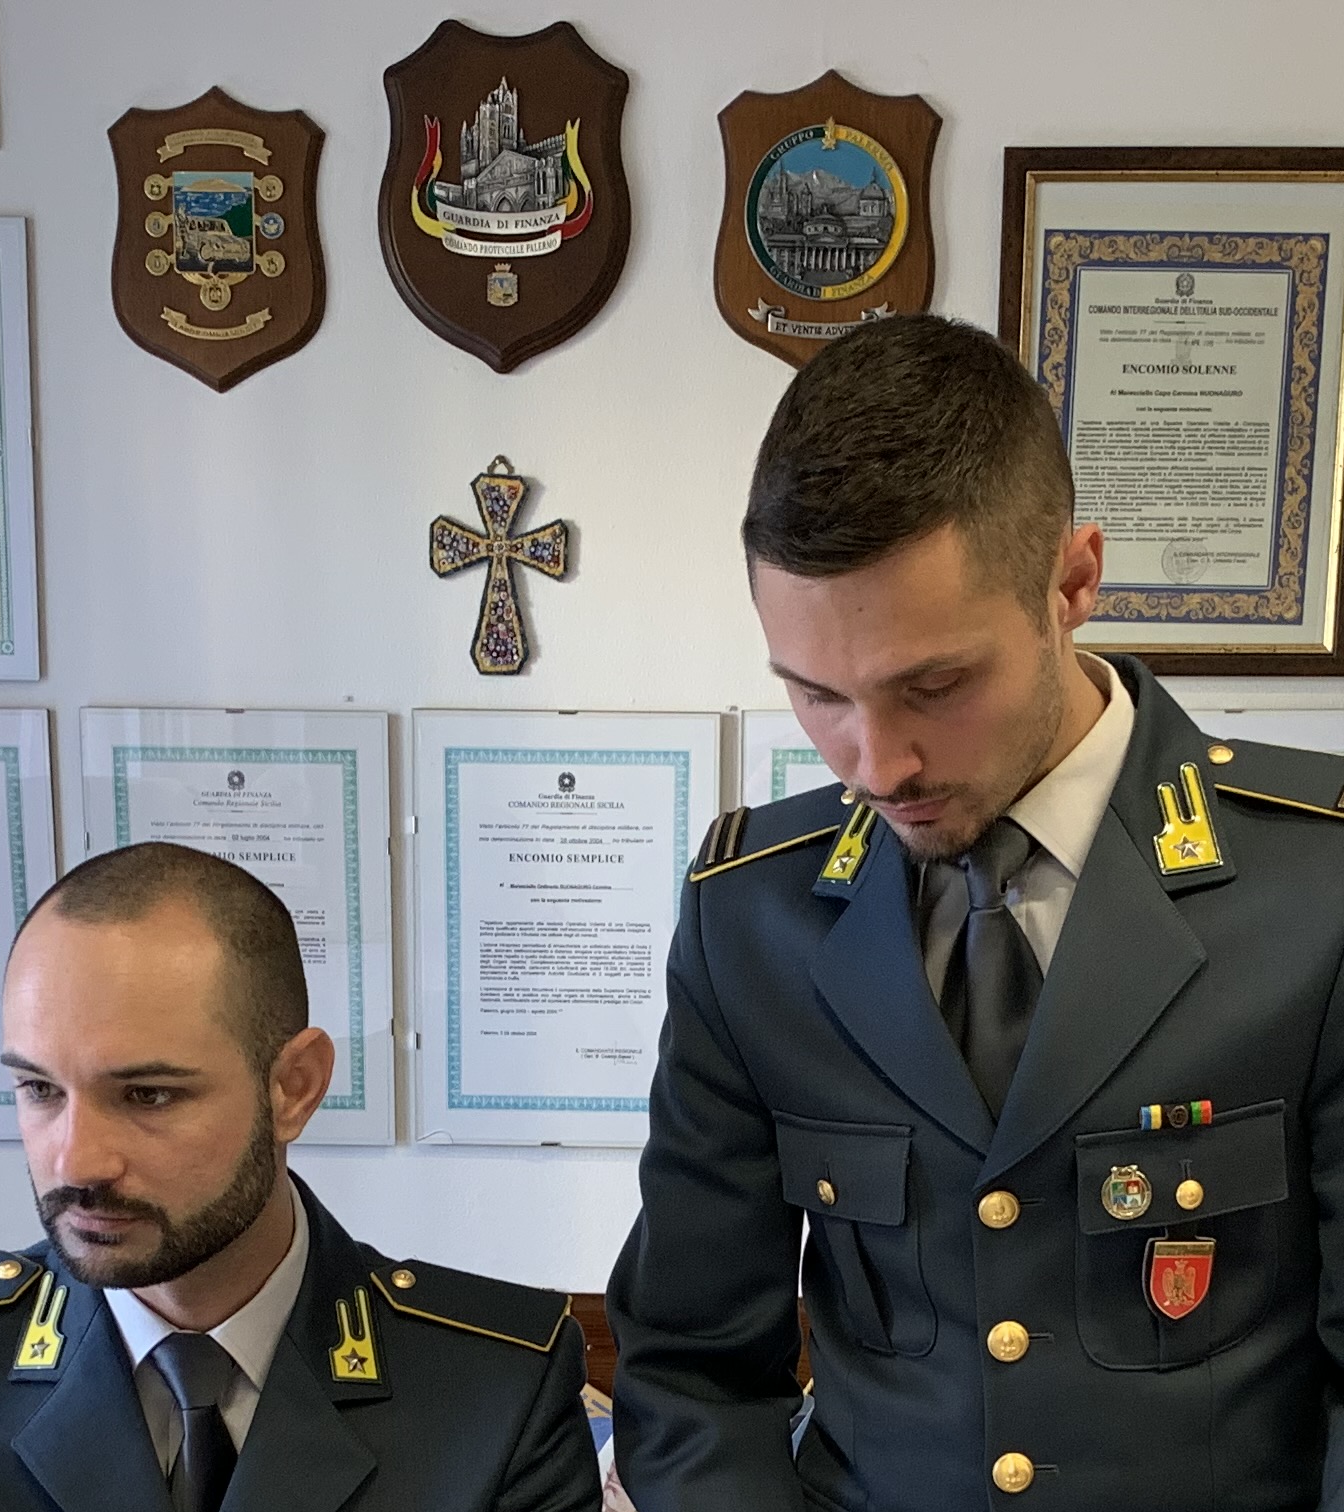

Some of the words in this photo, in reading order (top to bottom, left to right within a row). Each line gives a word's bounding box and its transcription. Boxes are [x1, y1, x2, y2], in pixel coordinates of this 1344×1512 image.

[770, 129, 814, 160] GRUPPO
[844, 130, 894, 172] PALERMO
[443, 211, 490, 228] GUARDIA
[497, 219, 508, 229] DI
[515, 213, 560, 228] FINANZA
[445, 237, 478, 253] COMANDO
[526, 238, 557, 252] PALERMO
[832, 274, 875, 296] FINANZA
[1089, 306, 1121, 314] COMANDO
[1219, 307, 1278, 316] SUD-OCCIDENTALE
[775, 322, 786, 331] ET
[791, 323, 821, 335] VENTIS
[1123, 364, 1179, 374] ENCOMIO
[1182, 364, 1236, 375] SOLENNE
[239, 852, 296, 862] SEMPLICE
[509, 854, 563, 863] ENCOMIO
[567, 854, 624, 863] SEMPLICE
